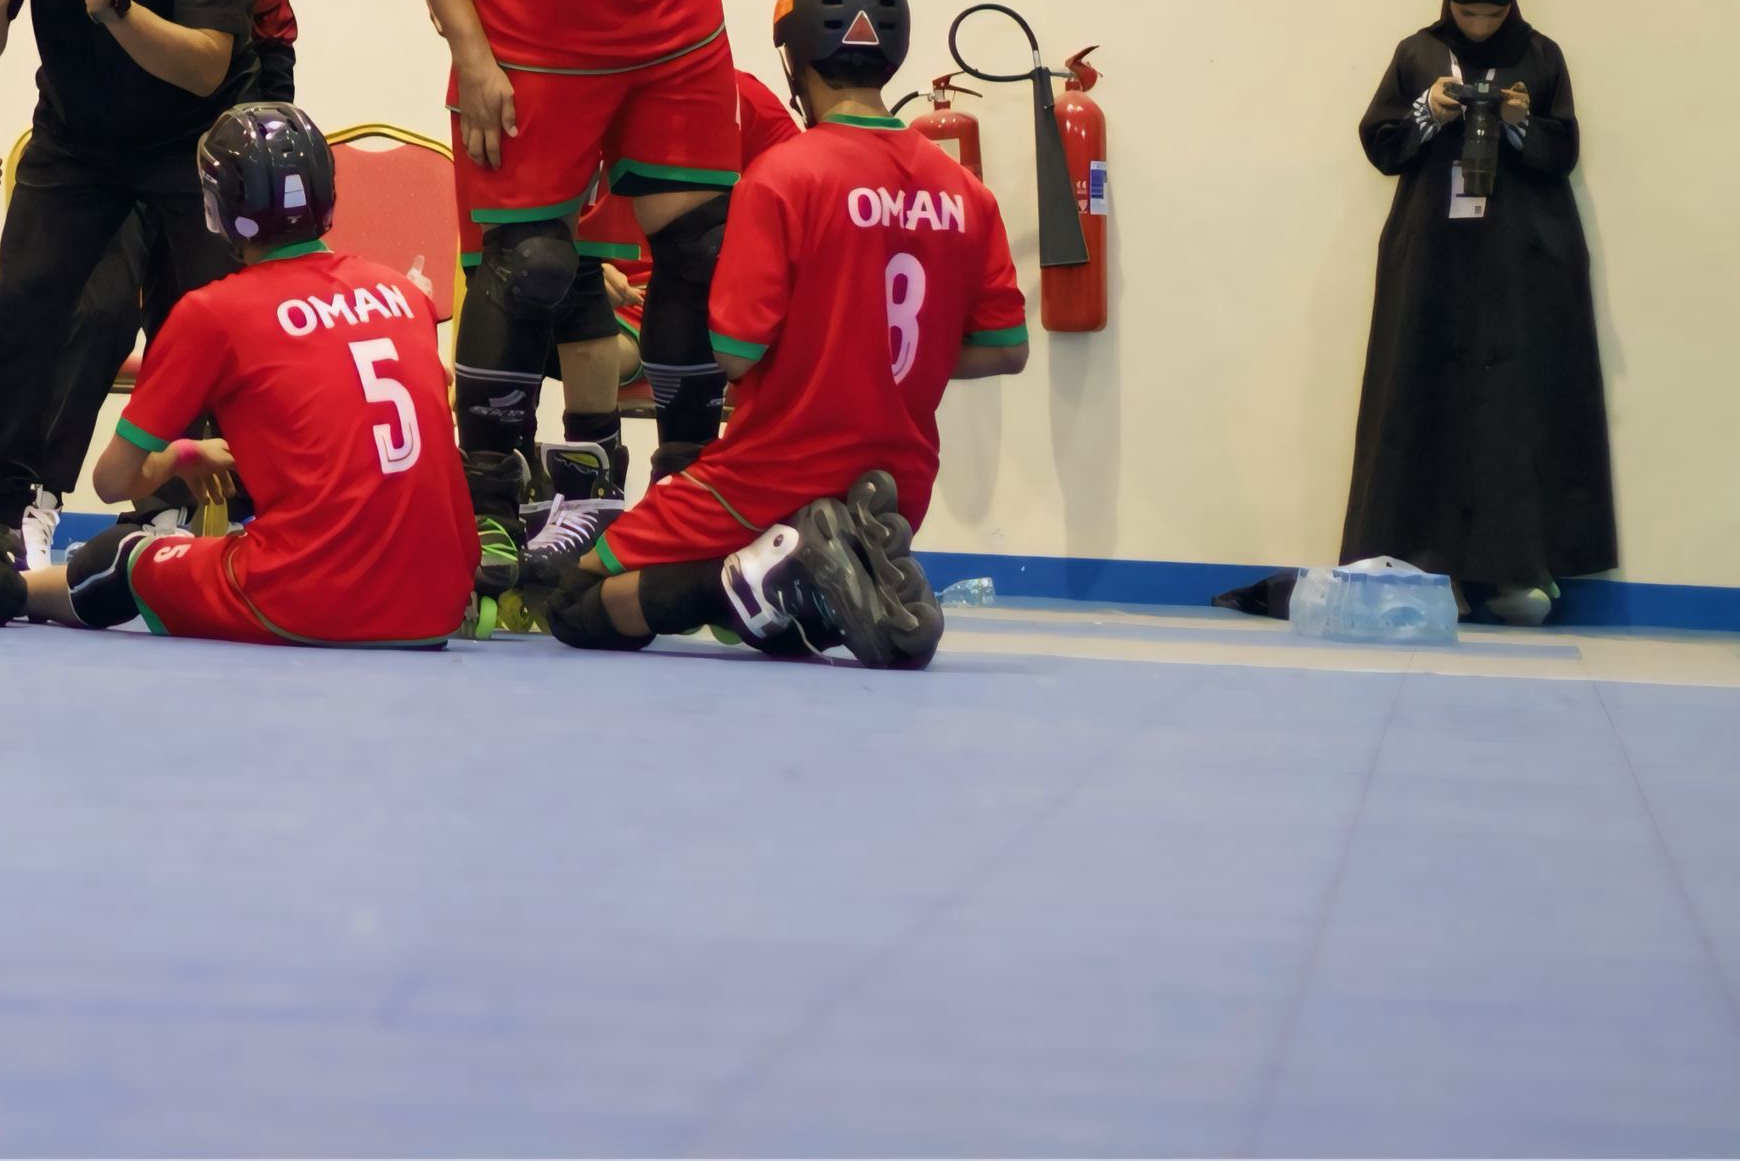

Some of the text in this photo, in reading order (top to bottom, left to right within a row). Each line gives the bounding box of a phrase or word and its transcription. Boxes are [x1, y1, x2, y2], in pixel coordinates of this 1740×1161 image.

[848, 187, 965, 233] OMAN
[277, 283, 414, 336] OMAN
[885, 252, 926, 385] 8
[348, 337, 422, 474] 5
[153, 543, 192, 563] 5
